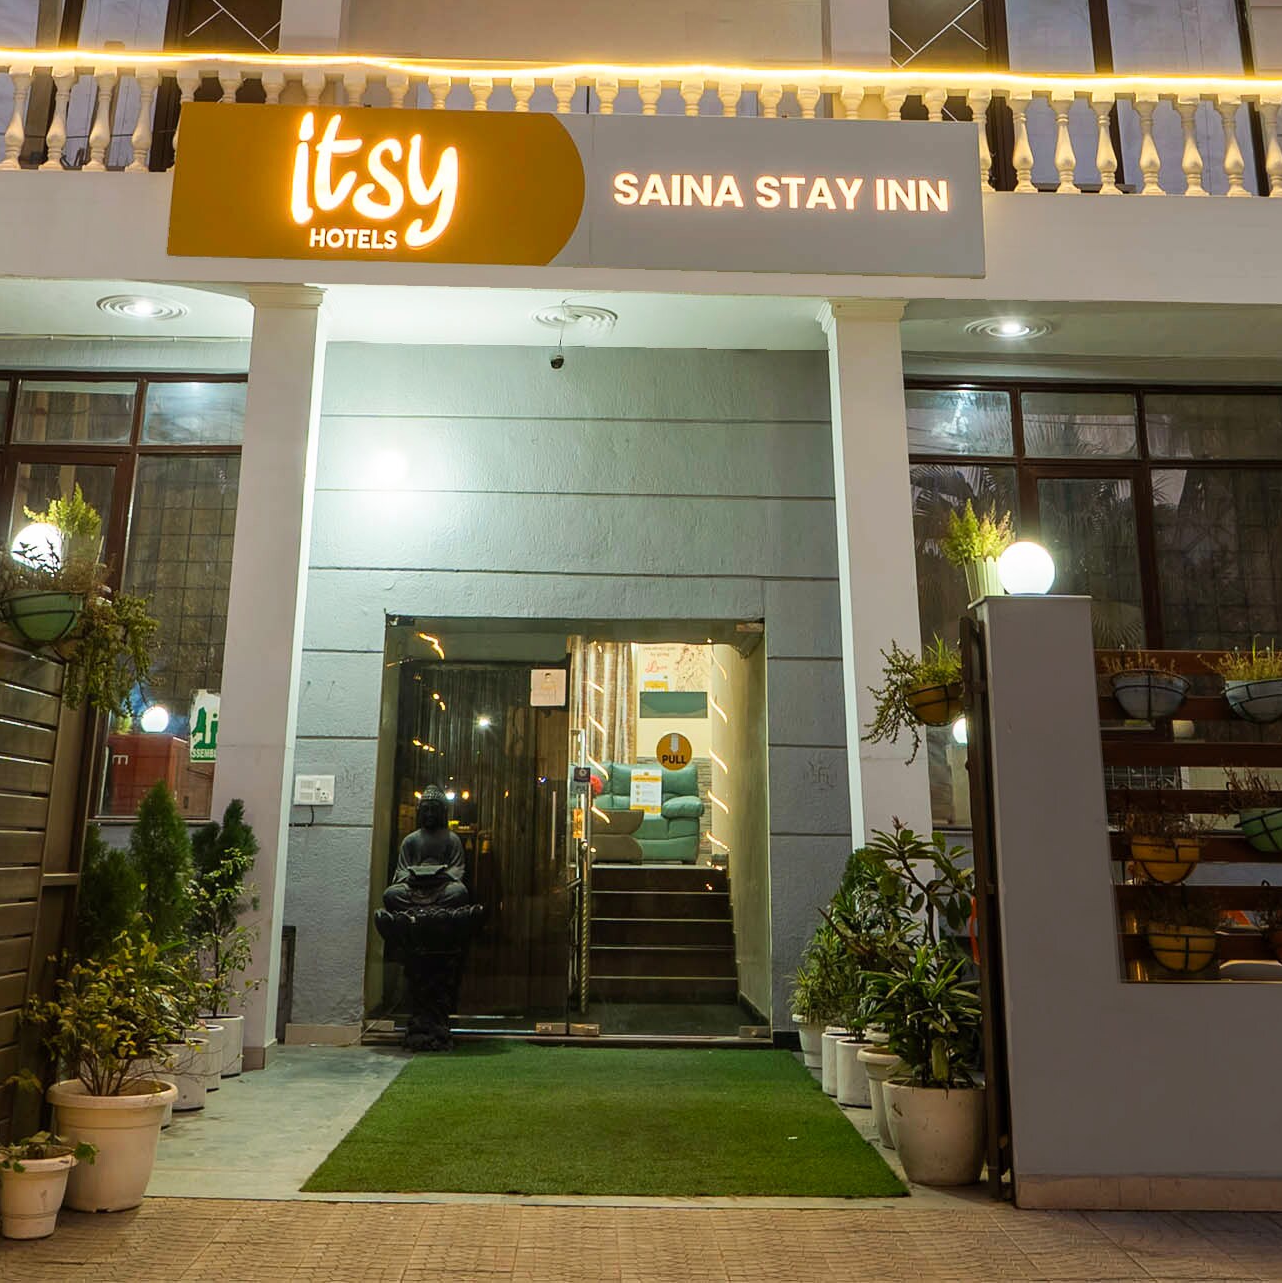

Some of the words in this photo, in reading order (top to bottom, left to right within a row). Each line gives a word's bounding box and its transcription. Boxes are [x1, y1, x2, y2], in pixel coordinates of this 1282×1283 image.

[291, 112, 459, 249] itsy
[614, 172, 745, 209] SAINA
[755, 176, 864, 211] STAY
[875, 179, 950, 213] INN
[309, 228, 398, 250] HOTELS
[661, 754, 687, 765] PULL
